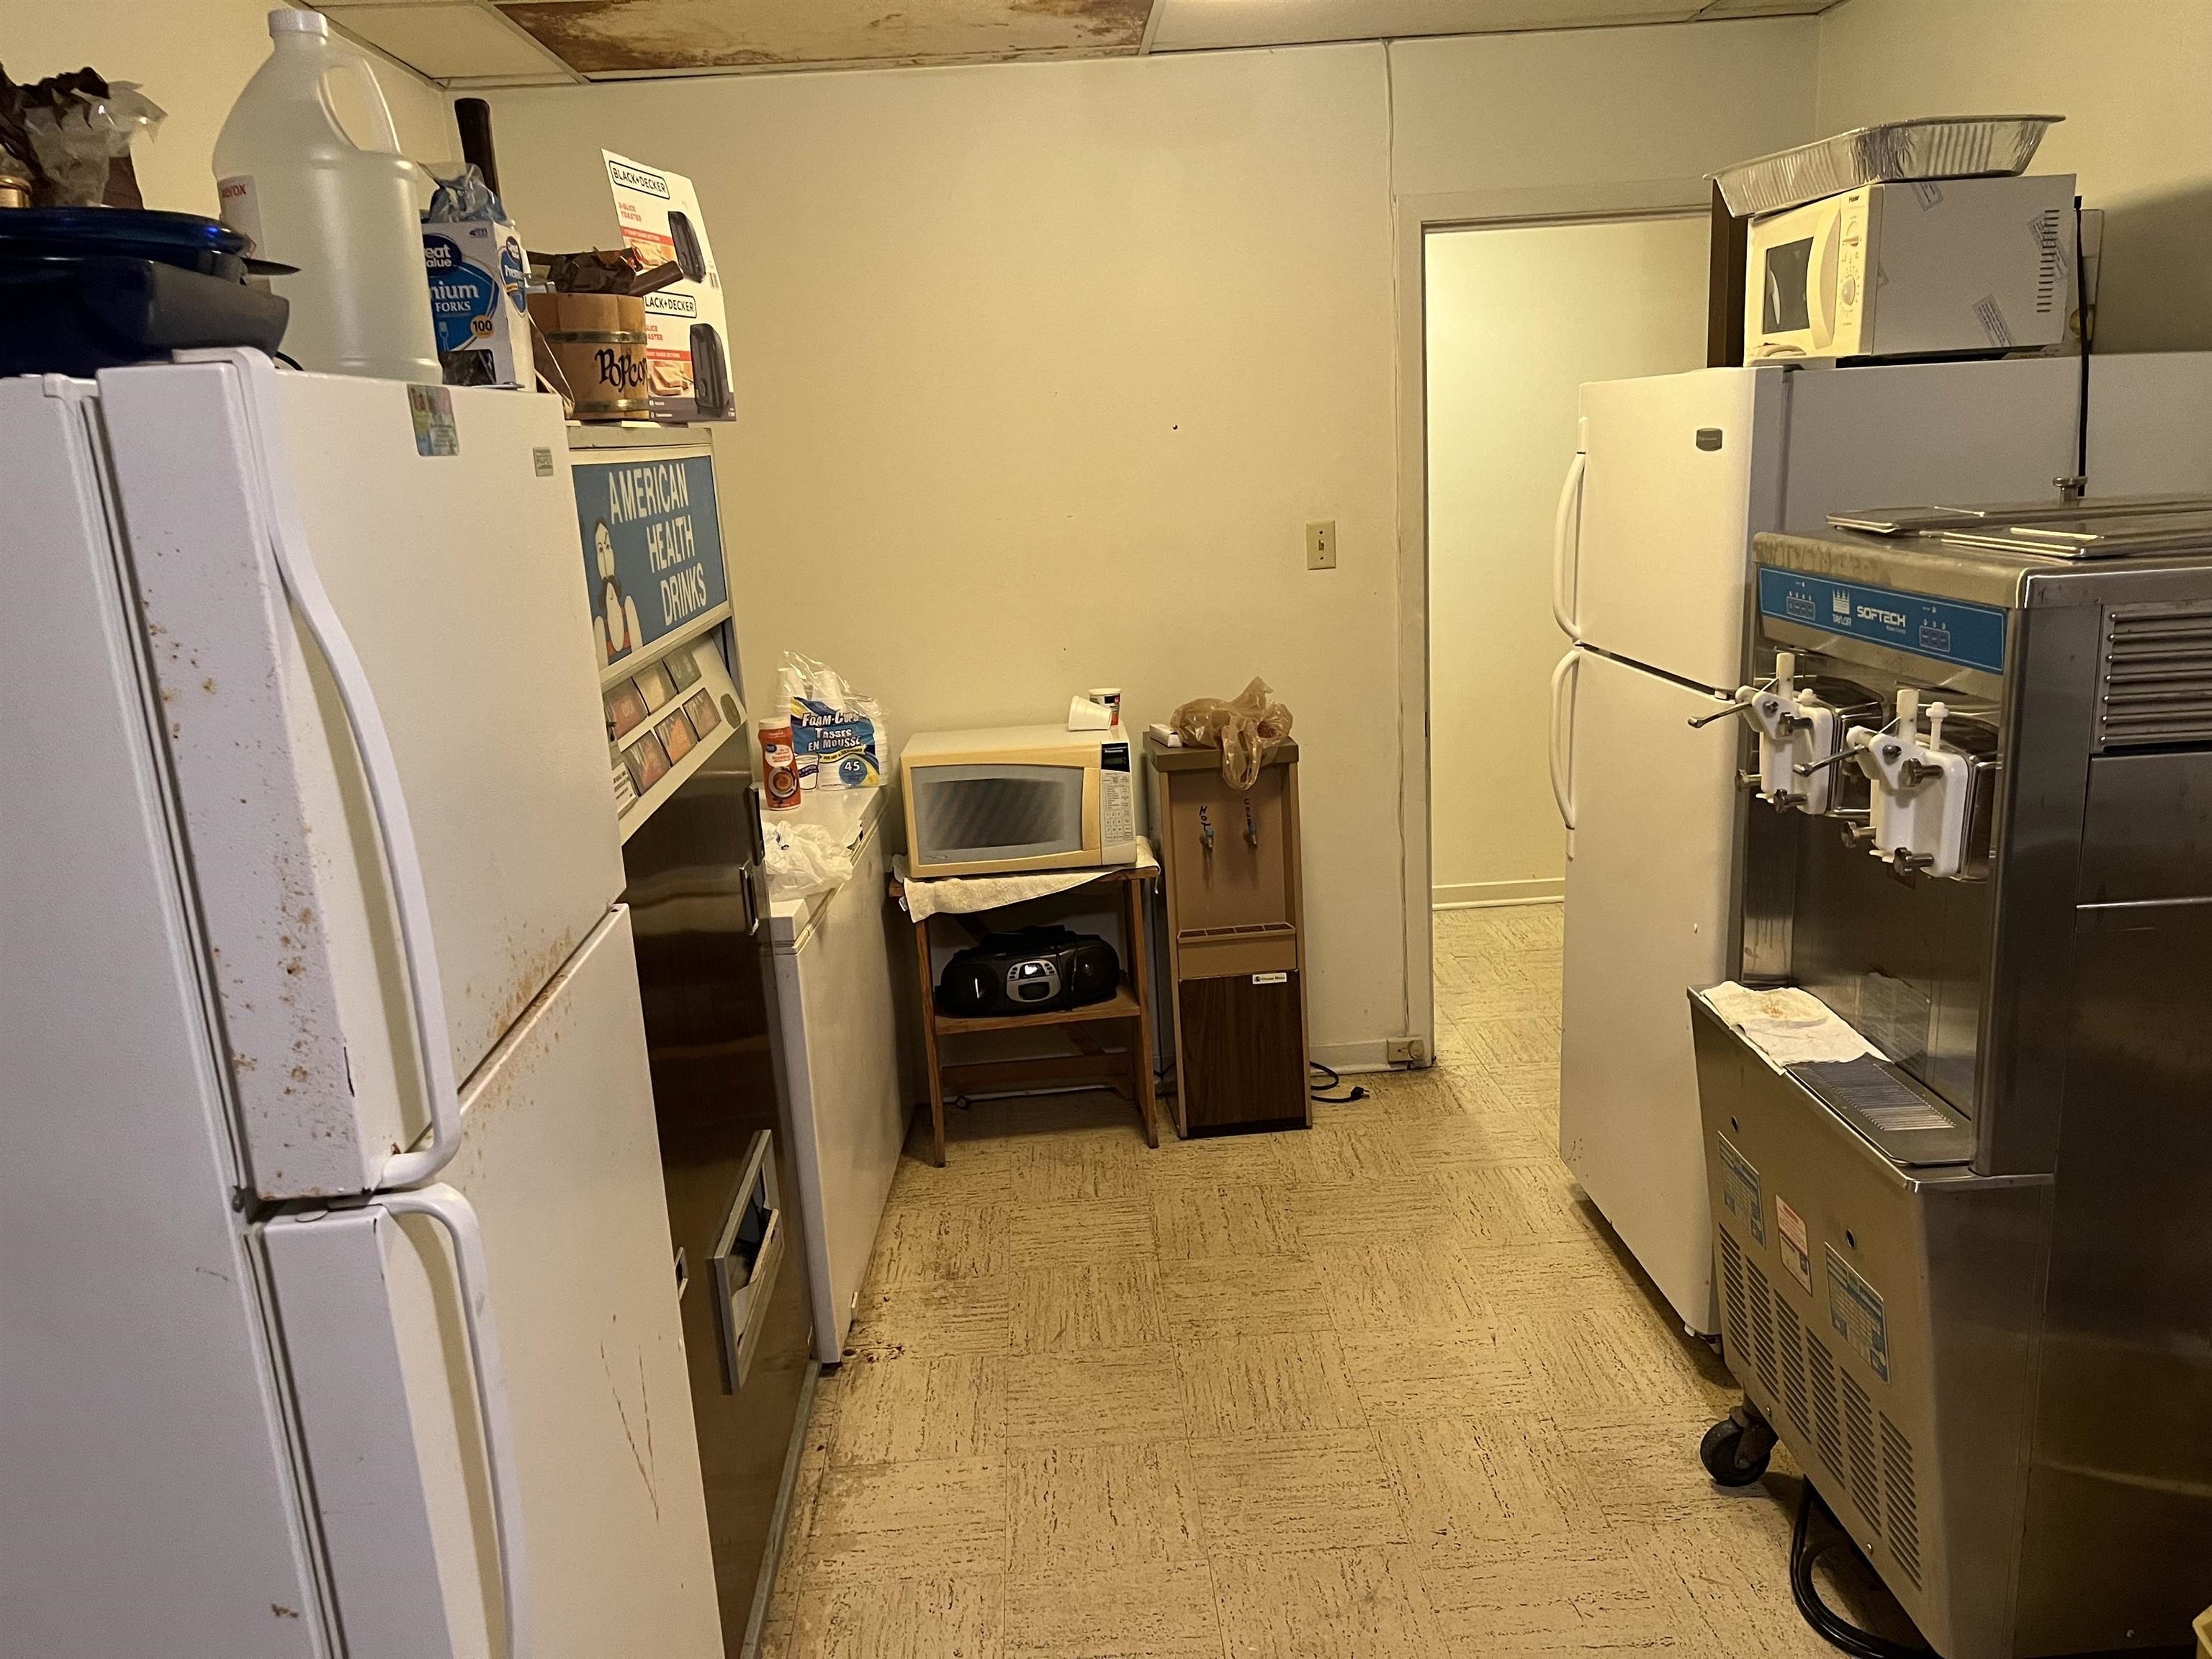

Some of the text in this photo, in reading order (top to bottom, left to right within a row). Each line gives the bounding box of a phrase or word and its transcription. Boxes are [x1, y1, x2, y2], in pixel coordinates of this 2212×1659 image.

[612, 167, 667, 193] BLACK+DECKER
[434, 301, 472, 313] FORKS
[472, 320, 493, 332] 100
[608, 462, 690, 525] AMERICAN
[646, 514, 696, 574] HEALTH
[660, 562, 708, 626] DRINKS
[1832, 606, 1907, 628] TAYLOR SOFTECH
[808, 735, 862, 752] EN MOUSSE
[844, 760, 860, 771] 45
[1199, 805, 1212, 832] HOT
